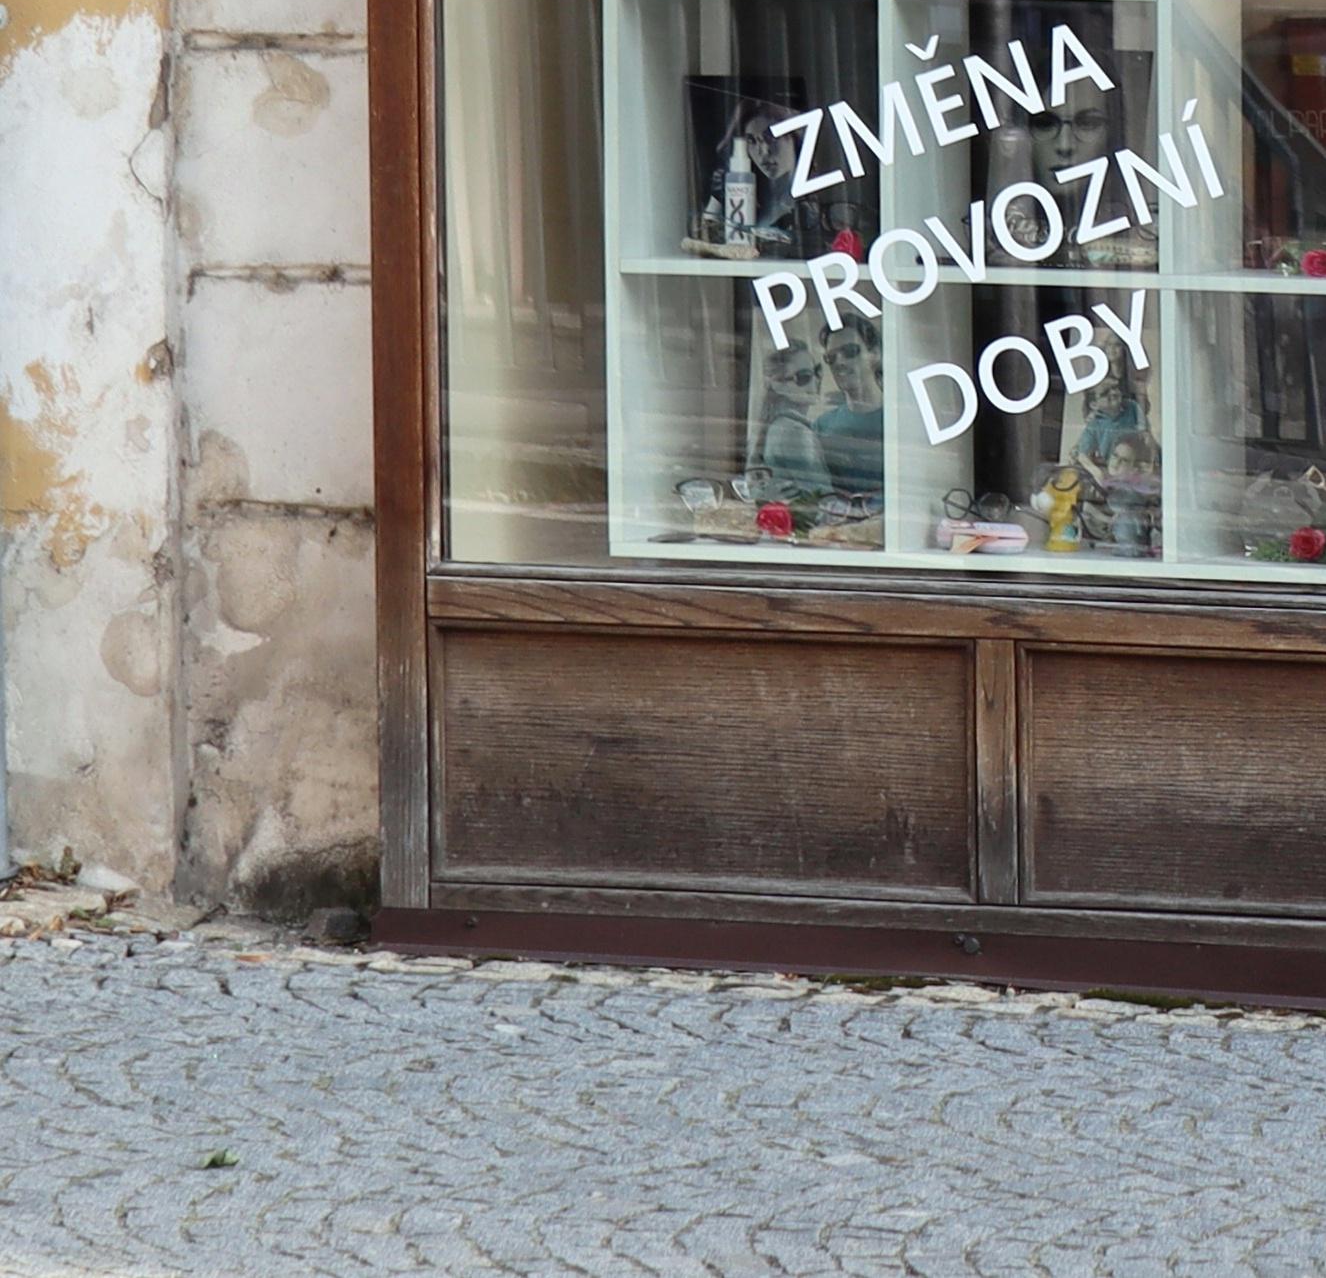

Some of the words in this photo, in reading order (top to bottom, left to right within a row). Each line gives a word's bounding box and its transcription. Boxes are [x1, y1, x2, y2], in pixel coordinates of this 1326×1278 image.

[769, 23, 1116, 199] ZMĚNA
[752, 98, 1224, 351] PROVOZNÍ
[907, 289, 1150, 446] DOBY
